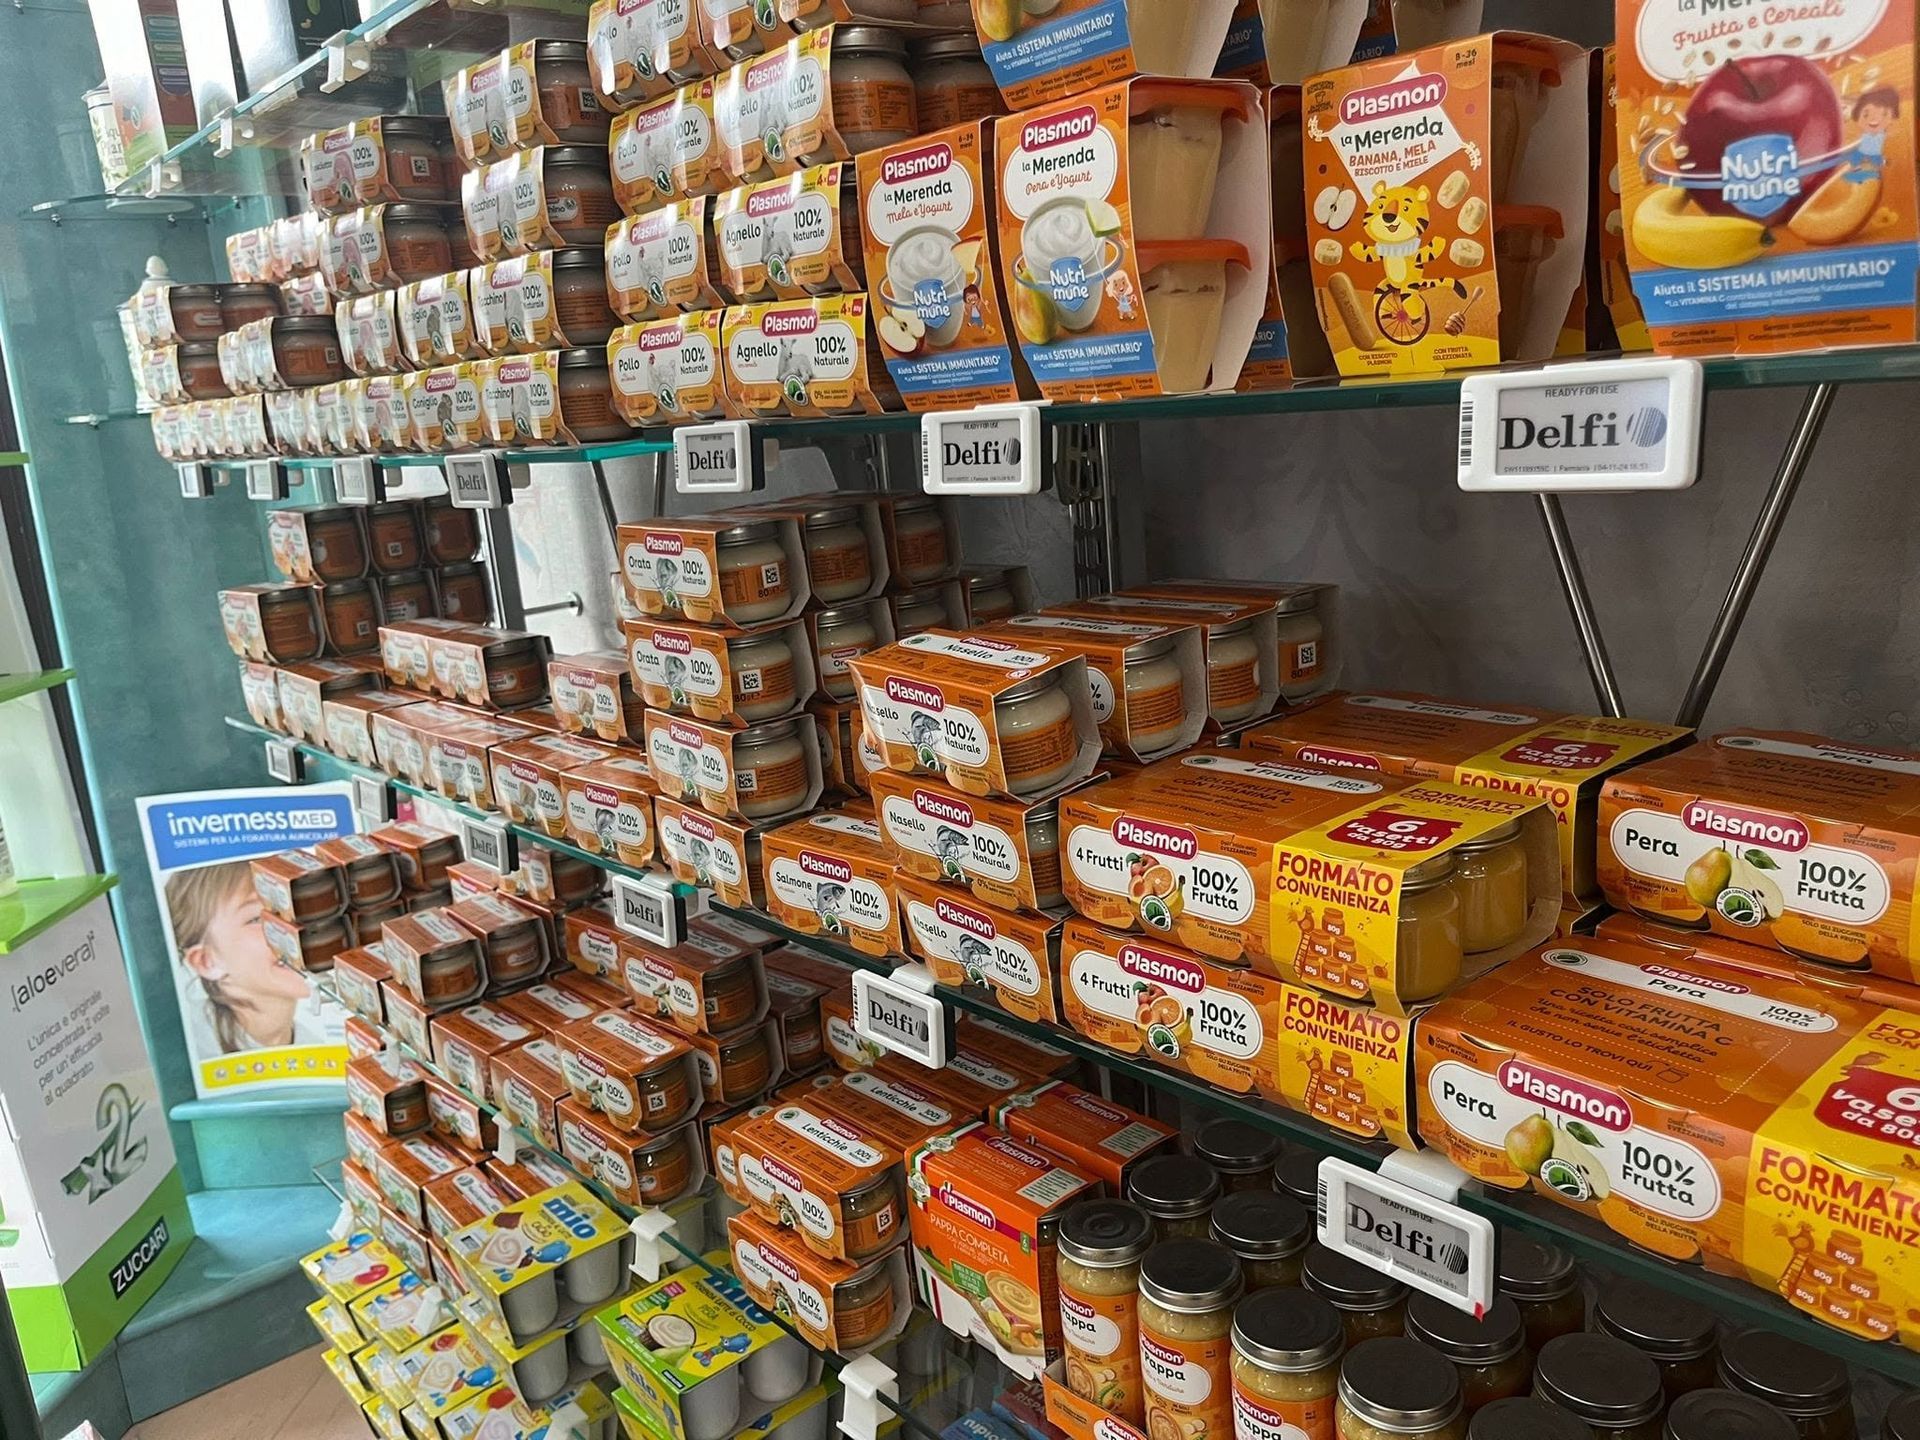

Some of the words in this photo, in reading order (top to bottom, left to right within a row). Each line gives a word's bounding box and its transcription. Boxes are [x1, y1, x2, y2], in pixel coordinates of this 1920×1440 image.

[1673, 21, 1744, 51] Frutta
[1748, 16, 1758, 28] e
[1763, 0, 1845, 26] Cereali
[1455, 48, 1477, 61] 8-36
[1455, 58, 1475, 69] mesi
[1346, 83, 1439, 119] Plasmon
[1024, 116, 1092, 147] Plasmon
[1341, 135, 1352, 147] la
[1355, 116, 1444, 152] Merenda
[884, 151, 949, 182] Plasmon
[1022, 161, 1031, 173] la
[1031, 146, 1095, 175] Merenda
[1349, 150, 1402, 168] BANANA,
[1404, 140, 1437, 157] MELA
[1721, 145, 1798, 181] Nutri
[1354, 164, 1394, 177] BISCOTTO
[1396, 162, 1402, 170] E
[1402, 157, 1429, 170] MIELE
[884, 192, 892, 203] la
[893, 180, 952, 207] Merenda
[1025, 180, 1049, 196] Pera
[1050, 177, 1056, 188] e
[1056, 171, 1092, 191] Yogurt
[1722, 177, 1801, 201] mune
[887, 208, 912, 224] Mela
[913, 207, 919, 217] e
[918, 201, 953, 218] Yogurt
[725, 224, 761, 247] Agnello
[792, 227, 826, 244] Naturale
[612, 252, 632, 270] Pollo
[1050, 268, 1086, 288] Nutri
[1653, 283, 1685, 297] Aiuta
[1687, 281, 1696, 294] il
[1697, 273, 1767, 293] SISTEMA
[912, 289, 947, 306] Nutri
[1053, 283, 1089, 300] mune
[916, 301, 951, 318] mune
[764, 313, 816, 333] Plasmon
[641, 329, 681, 349] Plasmon
[736, 341, 778, 362] Agnello
[814, 336, 847, 354] 100%
[619, 357, 641, 372] Pollo
[681, 347, 706, 365] 100%
[681, 360, 708, 376] Naturale
[814, 355, 850, 367] Naturale
[1545, 386, 1579, 398] READY
[1580, 385, 1597, 396] FOR
[1600, 384, 1619, 395] USE
[1499, 412, 1620, 450] Delfi
[689, 448, 725, 472] Delfi
[943, 441, 1001, 466] Delfi
[458, 474, 481, 491] Delfi
[629, 555, 651, 570] Orata
[681, 559, 704, 576] 100%
[636, 650, 660, 666] Orata
[942, 642, 993, 660] Nasello
[690, 659, 713, 676] 100%
[888, 680, 942, 709] Plasmon
[943, 717, 977, 743] 100%
[654, 739, 675, 756] Orata
[944, 735, 981, 755] Naturale
[1514, 745, 1603, 765] vasetti
[1552, 744, 1588, 756] 6
[1518, 753, 1540, 764] da
[916, 793, 971, 825] Plasmon
[1410, 787, 1526, 812] FORMATO
[167, 811, 288, 837] inverness
[292, 811, 334, 826] MED
[889, 810, 926, 832] Nasello
[1346, 820, 1438, 846] vasetti
[1387, 820, 1427, 834] 6
[1690, 806, 1801, 847] Plasmon
[211, 836, 226, 846] PER
[229, 834, 240, 844] LA
[241, 832, 287, 843] FORATURA
[472, 835, 492, 857] Delfi
[972, 833, 1007, 859] 100%
[1117, 822, 1194, 857] Plasmon
[1347, 832, 1371, 843] da
[1371, 834, 1408, 850] 80g
[1625, 828, 1679, 857] Pera
[802, 853, 850, 880] Plasmon
[972, 852, 1011, 872] Naturale
[1076, 847, 1084, 862] 4
[1086, 849, 1124, 872] Frutti
[775, 870, 812, 891] Salmone
[1191, 866, 1239, 895] 100%
[1277, 851, 1394, 897] FORMATO
[1799, 859, 1867, 892] 100%
[849, 888, 879, 910] 100%
[1191, 886, 1239, 911] Frutta
[1275, 875, 1391, 916] CONVENIENZA
[1797, 881, 1865, 910] Frutta
[626, 899, 655, 923] Delfi
[849, 904, 882, 920] Naturale
[938, 902, 994, 937] Plasmon
[994, 945, 1029, 973] 100%
[1124, 951, 1203, 988] Plasmon
[995, 963, 1032, 986] Naturale
[1080, 972, 1089, 987] 4
[1091, 975, 1131, 999] Frutti
[1648, 977, 1706, 1000] Pera
[869, 1000, 915, 1037] Delfi
[1199, 1000, 1247, 1030] 100%
[1285, 992, 1401, 1044] FORMATO
[1549, 988, 1599, 1007] CON
[1604, 1002, 1708, 1040] VITAMINA
[1714, 1036, 1734, 1046] C
[1577, 986, 1635, 1006] SOLO
[1639, 1003, 1721, 1032] FRUTTA
[1759, 1011, 1809, 1028] Frutta
[33, 1025, 86, 1070] concentrata
[86, 1017, 92, 1030] 2
[1200, 1019, 1248, 1047] Frutta
[1283, 1015, 1399, 1063] CONVENIENZA
[1507, 1019, 1518, 1028] IL
[1520, 1023, 1563, 1043] GUSTO
[1563, 1038, 1583, 1049] LO
[1585, 1045, 1625, 1062] TROVI
[1626, 1058, 1654, 1072] QUI
[55, 1060, 95, 1098] quadrato
[870, 1086, 918, 1112] Lenticchie
[1443, 1080, 1497, 1120] Pera
[1506, 1066, 1625, 1128] Plasmon
[801, 1123, 849, 1152] Lenticchie
[1622, 1140, 1695, 1186] 100%
[1622, 1164, 1694, 1206] Frutta
[930, 1213, 958, 1237] PAPPA
[958, 1229, 1010, 1266] COMPLETA
[1347, 1201, 1437, 1265] Delfi
[112, 1217, 168, 1293] ZUCCARI
[1834, 1250, 1856, 1265] 80g
[1813, 1269, 1833, 1284] 80g
[1795, 1288, 1815, 1303] 80g
[1850, 1283, 1871, 1298] 80g
[1829, 1304, 1850, 1319] 80g
[1867, 1318, 1888, 1333] 80g
[1143, 1352, 1186, 1382] Pappa
